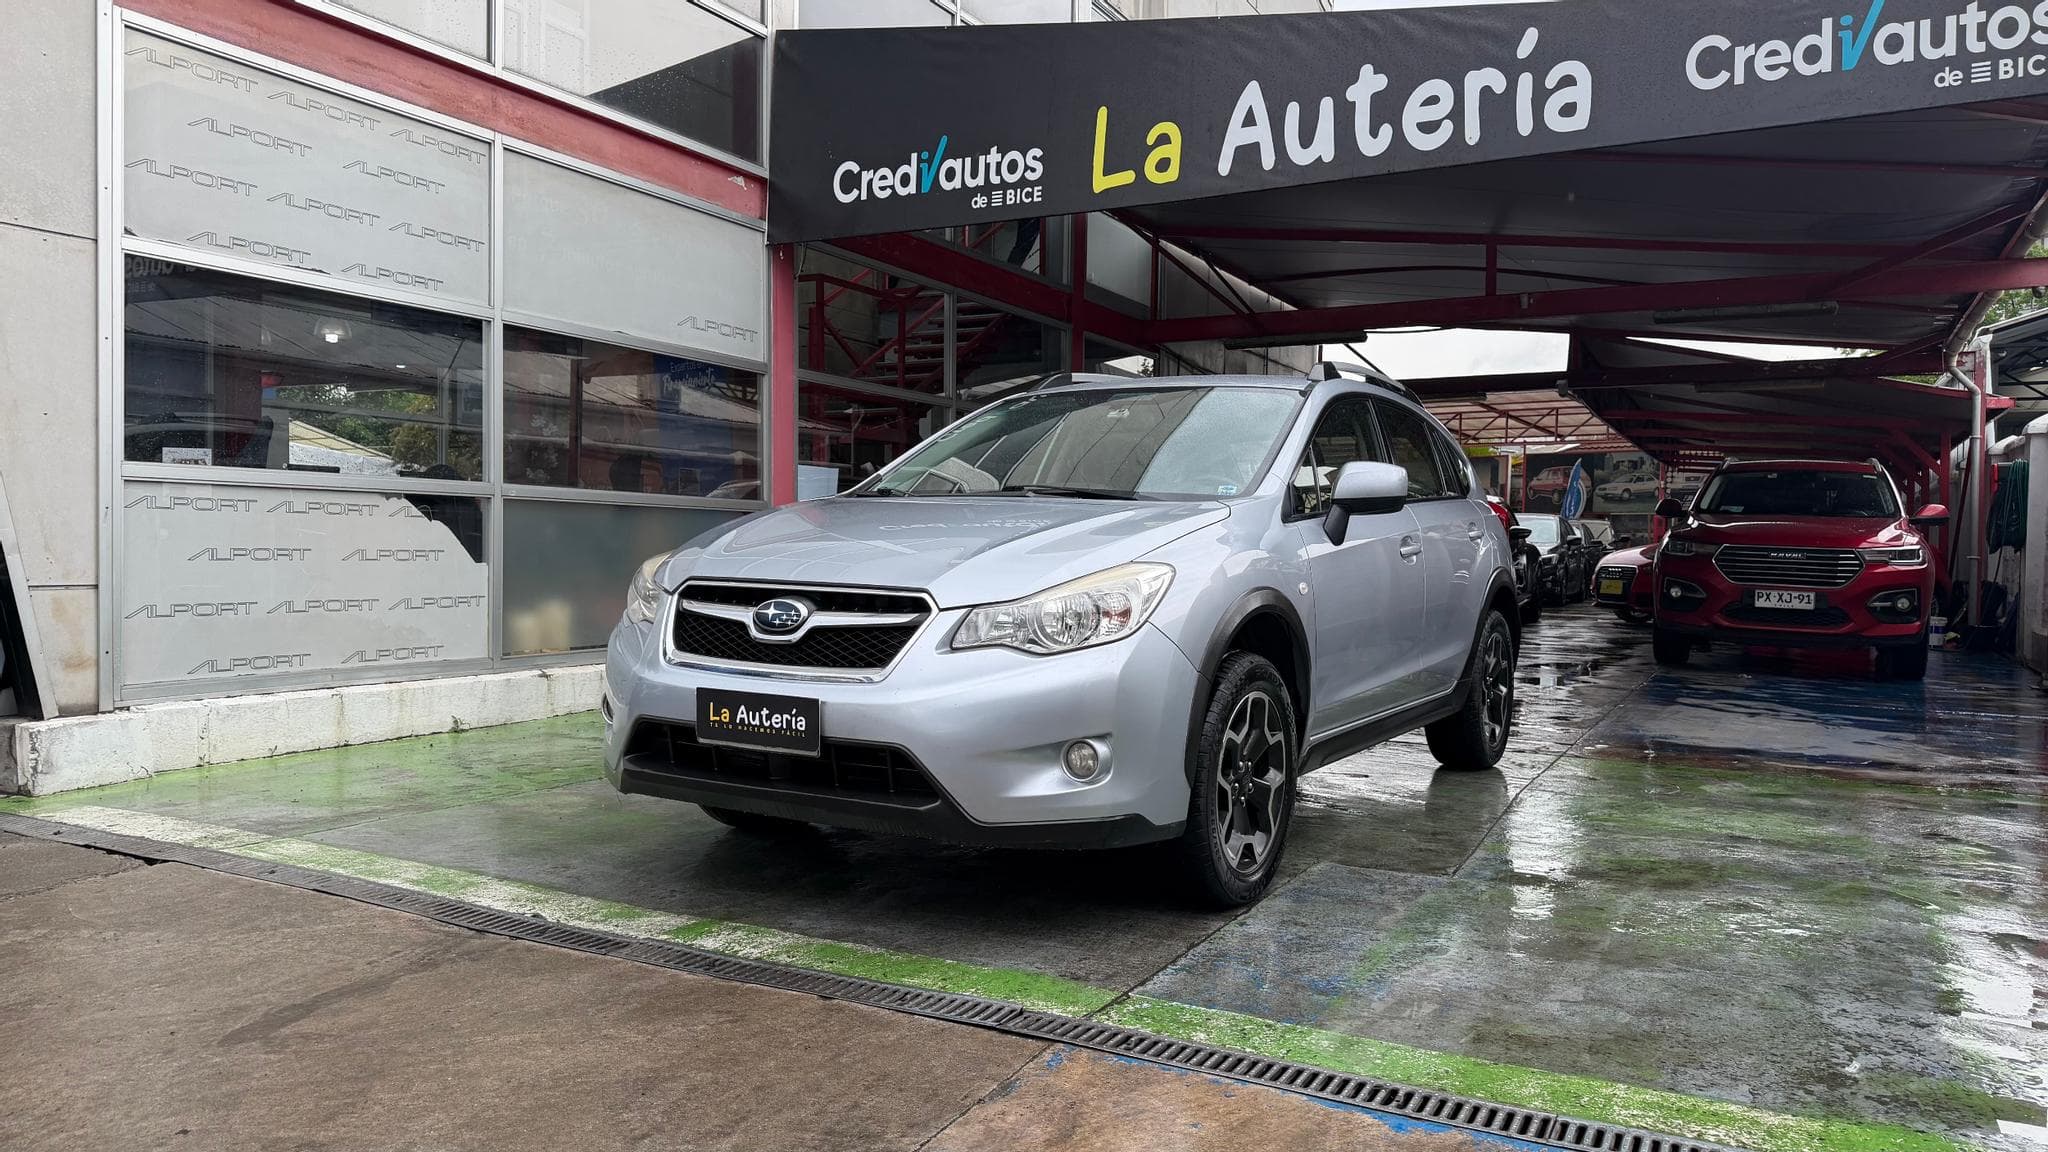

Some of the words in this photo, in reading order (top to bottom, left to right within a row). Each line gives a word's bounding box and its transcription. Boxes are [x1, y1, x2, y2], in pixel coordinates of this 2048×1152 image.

[1934, 67, 1963, 88] de
[1092, 105, 1182, 194] La
[1217, 26, 1592, 177] Autería
[971, 192, 988, 209] de
[1006, 186, 1043, 204] BICE
[709, 702, 730, 722] La
[736, 704, 806, 731] Autería
